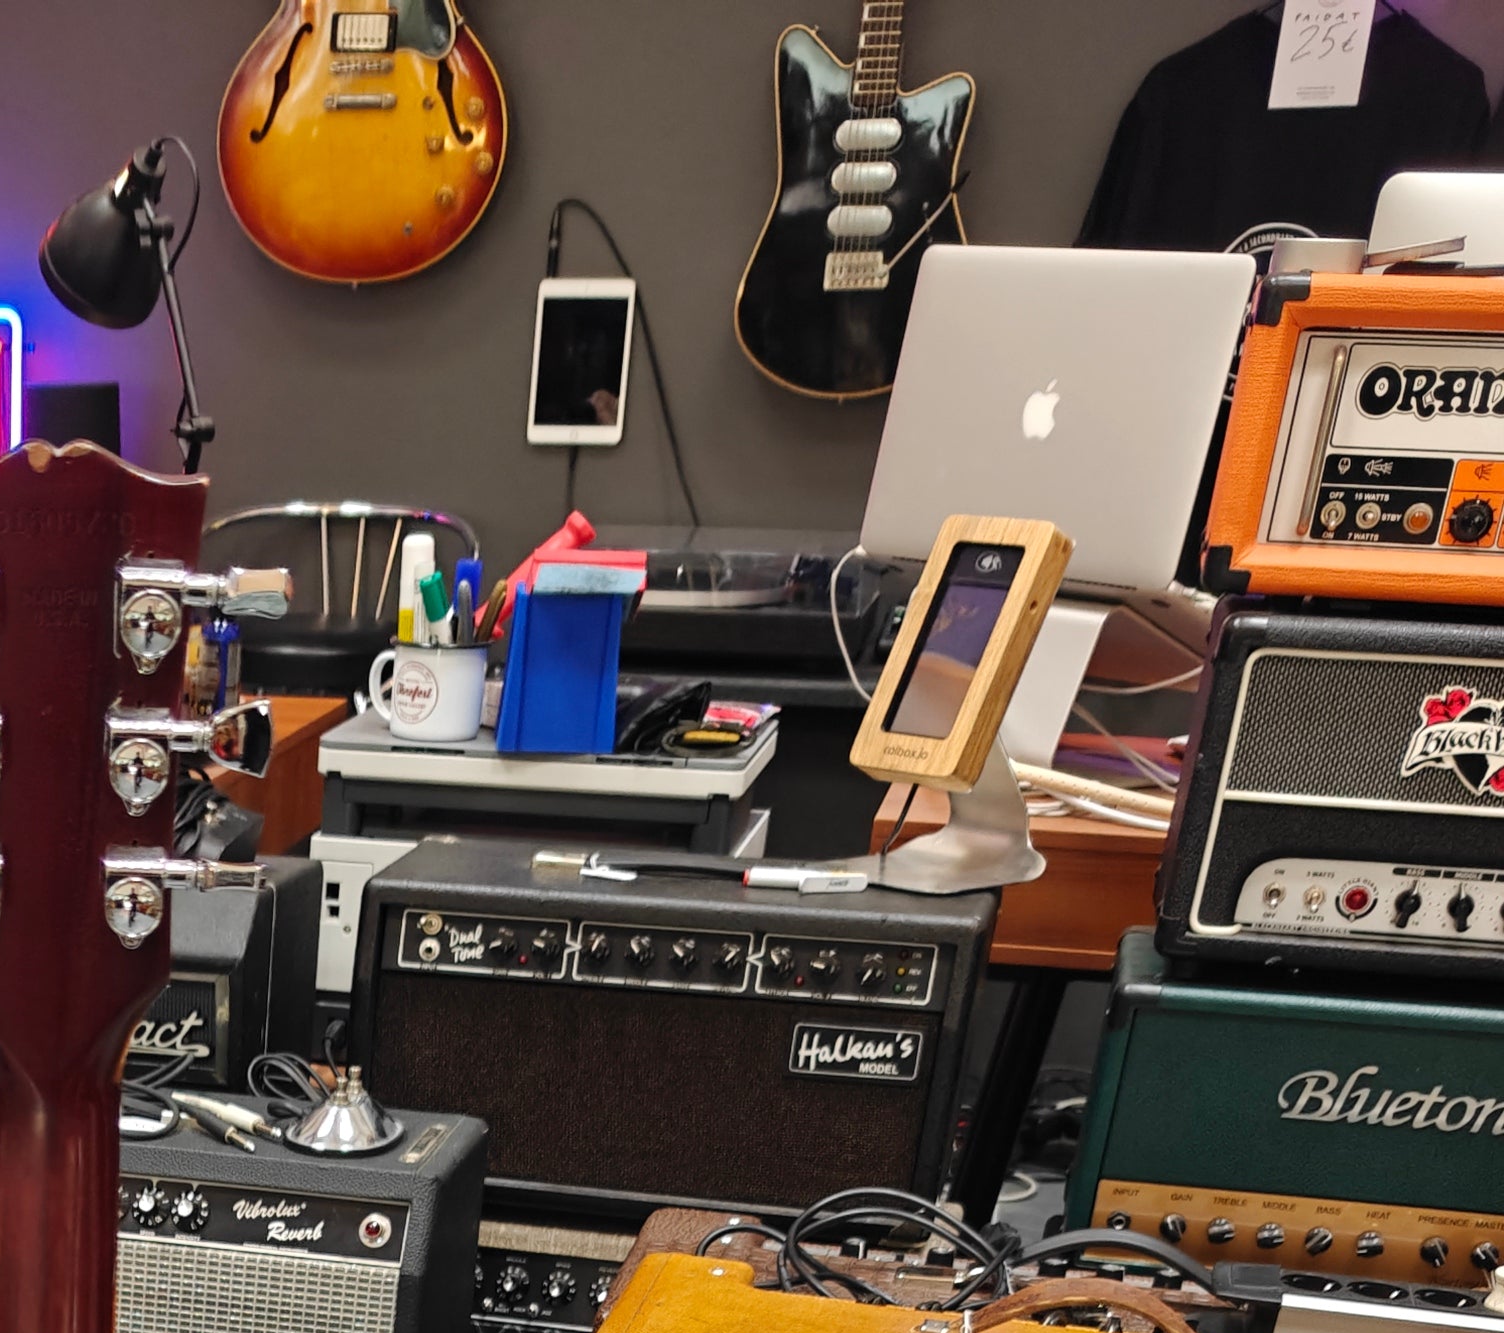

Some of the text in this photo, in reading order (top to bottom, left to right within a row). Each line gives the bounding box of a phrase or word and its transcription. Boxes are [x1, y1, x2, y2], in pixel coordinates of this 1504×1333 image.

[1329, 491, 1345, 500] OFF
[1363, 493, 1390, 502] WATTS
[1381, 513, 1402, 523] STBY
[1322, 531, 1334, 540] ON
[1353, 532, 1380, 542] WATTS
[1311, 871, 1335, 880] WATTS
[1405, 868, 1426, 877] BASS
[1454, 872, 1483, 881] MIDDLE
[1301, 914, 1324, 923] WATTS
[448, 924, 484, 947] Dual
[450, 945, 485, 964] Tone
[859, 1062, 899, 1076] MODEL
[232, 1199, 302, 1220] Vibrolux
[1112, 1187, 1139, 1197] INPUT
[1171, 1193, 1193, 1203] GAIN
[1213, 1196, 1247, 1207] TREBLE
[1262, 1201, 1295, 1212] MIDDLE
[1316, 1205, 1342, 1216] BASS
[1365, 1211, 1391, 1221] HEAT
[1418, 1214, 1470, 1228] PRESENCE
[267, 1221, 325, 1242] Reverb
